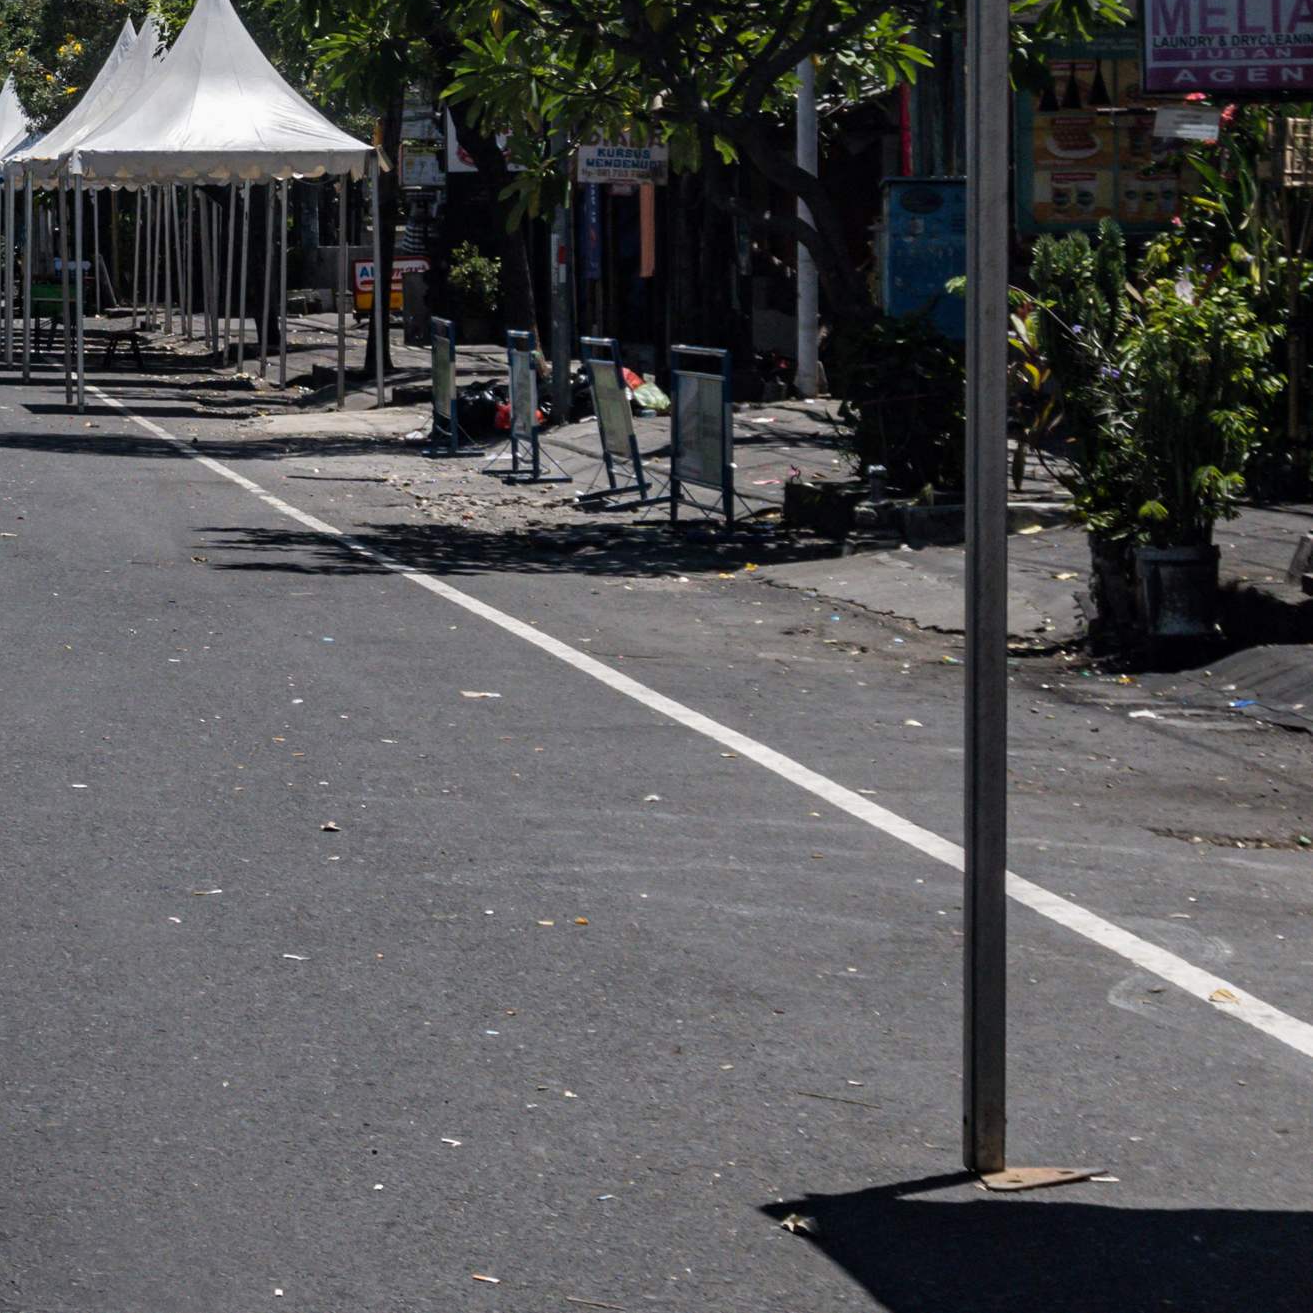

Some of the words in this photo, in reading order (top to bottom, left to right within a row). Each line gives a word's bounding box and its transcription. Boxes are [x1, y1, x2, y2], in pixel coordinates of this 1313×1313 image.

[1153, 36, 1214, 48] LAUNDRY
[1219, 36, 1227, 47] &
[1189, 48, 1291, 59] TUBAN
[1173, 67, 1304, 83] AGEN
[597, 148, 651, 159] KURSUS
